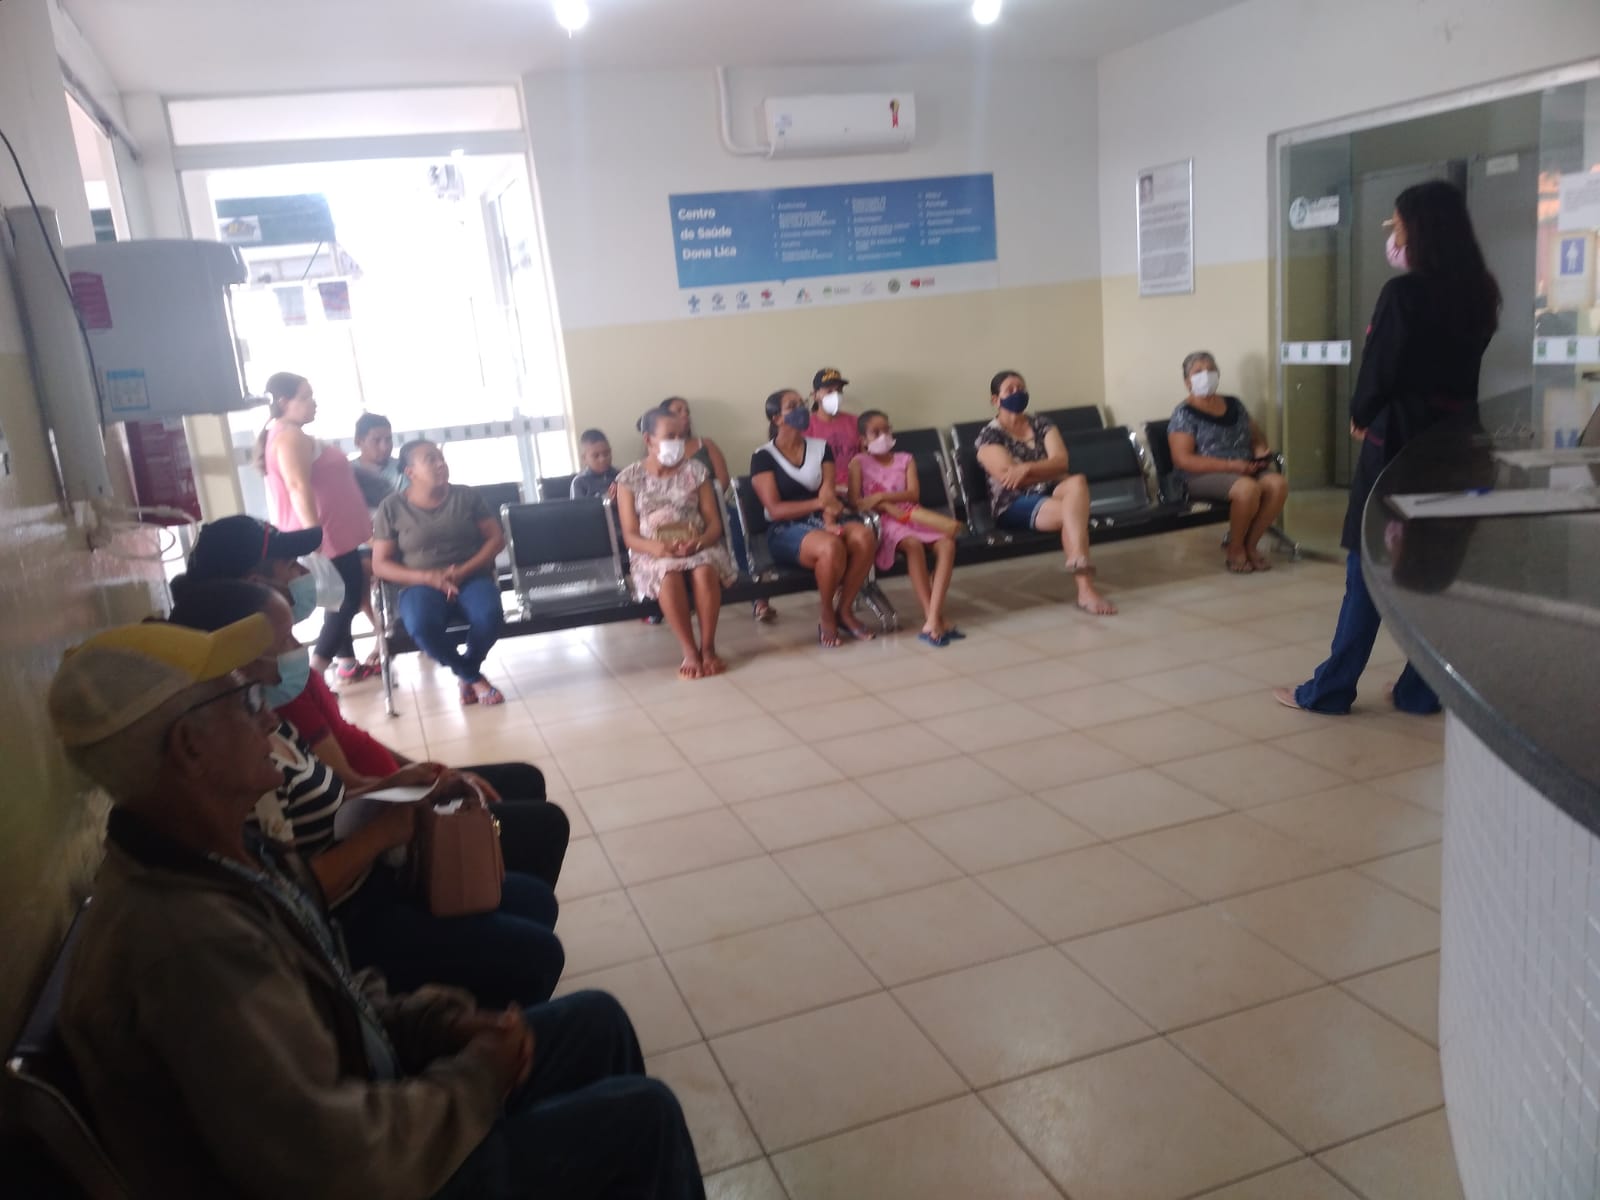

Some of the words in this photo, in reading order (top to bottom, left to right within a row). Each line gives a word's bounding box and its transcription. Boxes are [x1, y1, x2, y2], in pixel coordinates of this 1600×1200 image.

[678, 207, 716, 220] Centro
[680, 228, 695, 240] de
[697, 225, 732, 239] Saúde
[682, 247, 711, 260] Dona
